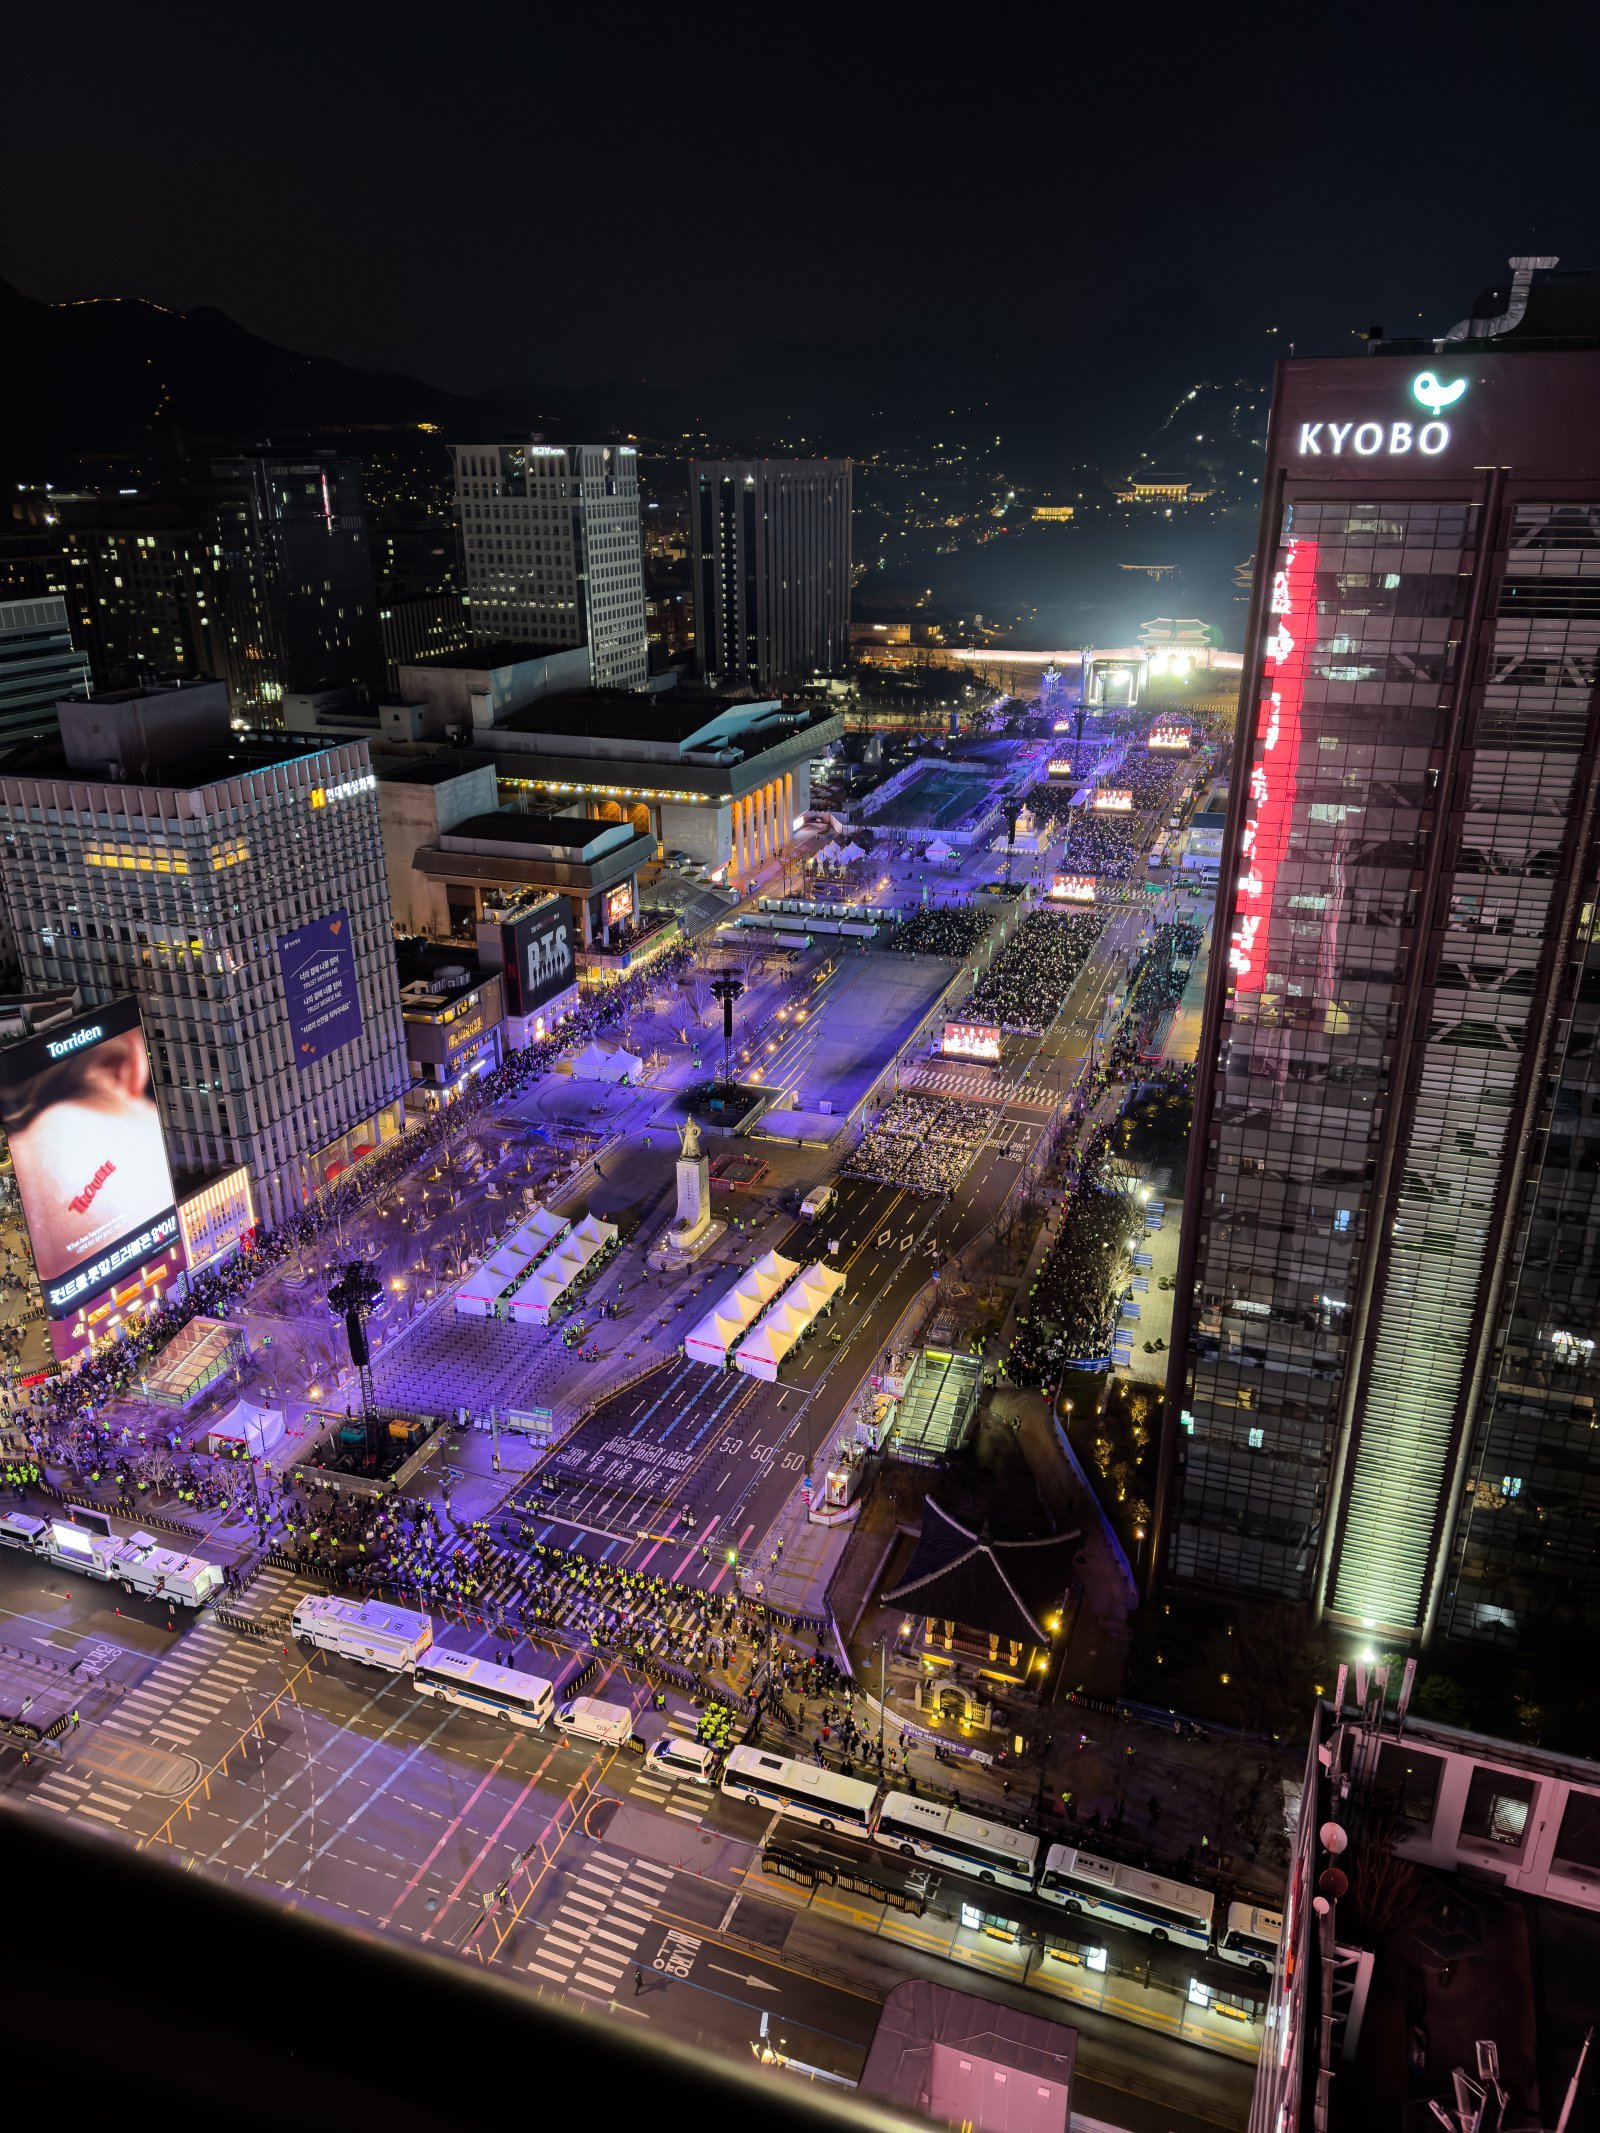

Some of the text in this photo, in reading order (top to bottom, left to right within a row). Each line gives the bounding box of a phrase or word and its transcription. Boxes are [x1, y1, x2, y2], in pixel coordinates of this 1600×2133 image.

[1298, 421, 1450, 455] KYOBO
[326, 775, 376, 803] 현대해상화재
[527, 924, 571, 990] BTS
[303, 978, 317, 990] TRUST
[307, 1002, 320, 1014] TRUST
[1053, 1026, 1067, 1034] 50
[1074, 1028, 1088, 1038] 50
[46, 1024, 103, 1058] Torriden
[68, 1159, 117, 1215] TROUBLE
[49, 1273, 89, 1306] 컨트롤
[109, 1232, 152, 1271] 트러블은
[719, 1436, 743, 1455] 50
[751, 1444, 774, 1463] 50
[781, 1451, 805, 1471] 50
[508, 1706, 523, 1715] POLICE
[995, 1866, 1013, 1875] POLICE
[1169, 1924, 1188, 1933] POLICE
